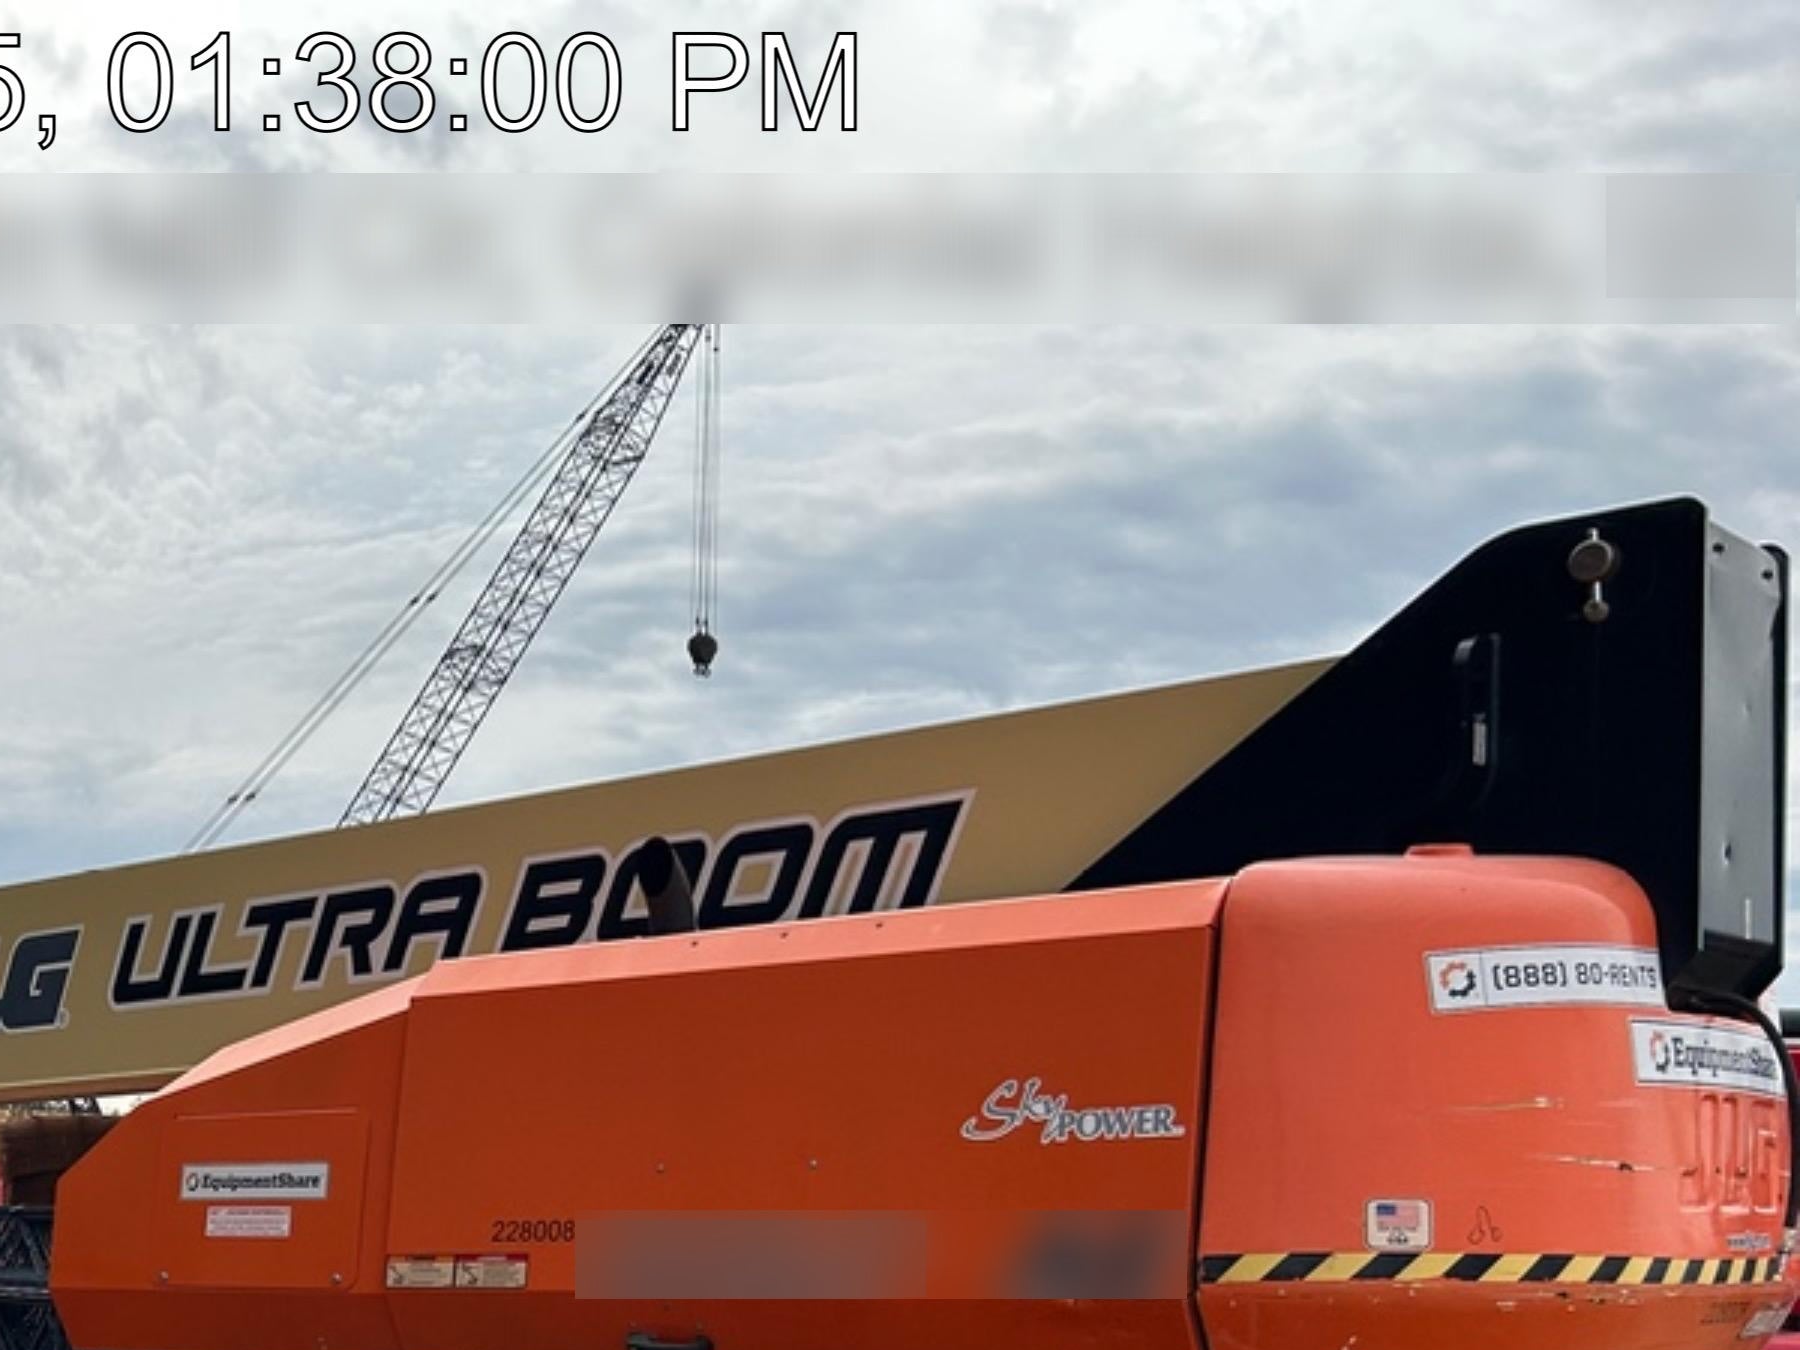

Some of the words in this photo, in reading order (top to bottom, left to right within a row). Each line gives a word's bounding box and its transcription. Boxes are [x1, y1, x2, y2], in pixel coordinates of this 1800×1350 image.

[111, 868, 484, 1007] ULTRA
[498, 796, 972, 953] BOOM
[1493, 961, 1567, 990] (888)
[1574, 961, 1657, 988] 80-RENTS
[961, 1077, 1068, 1144] Sky
[1057, 1105, 1184, 1142] POWER
[201, 1172, 321, 1192] EquipmentShare
